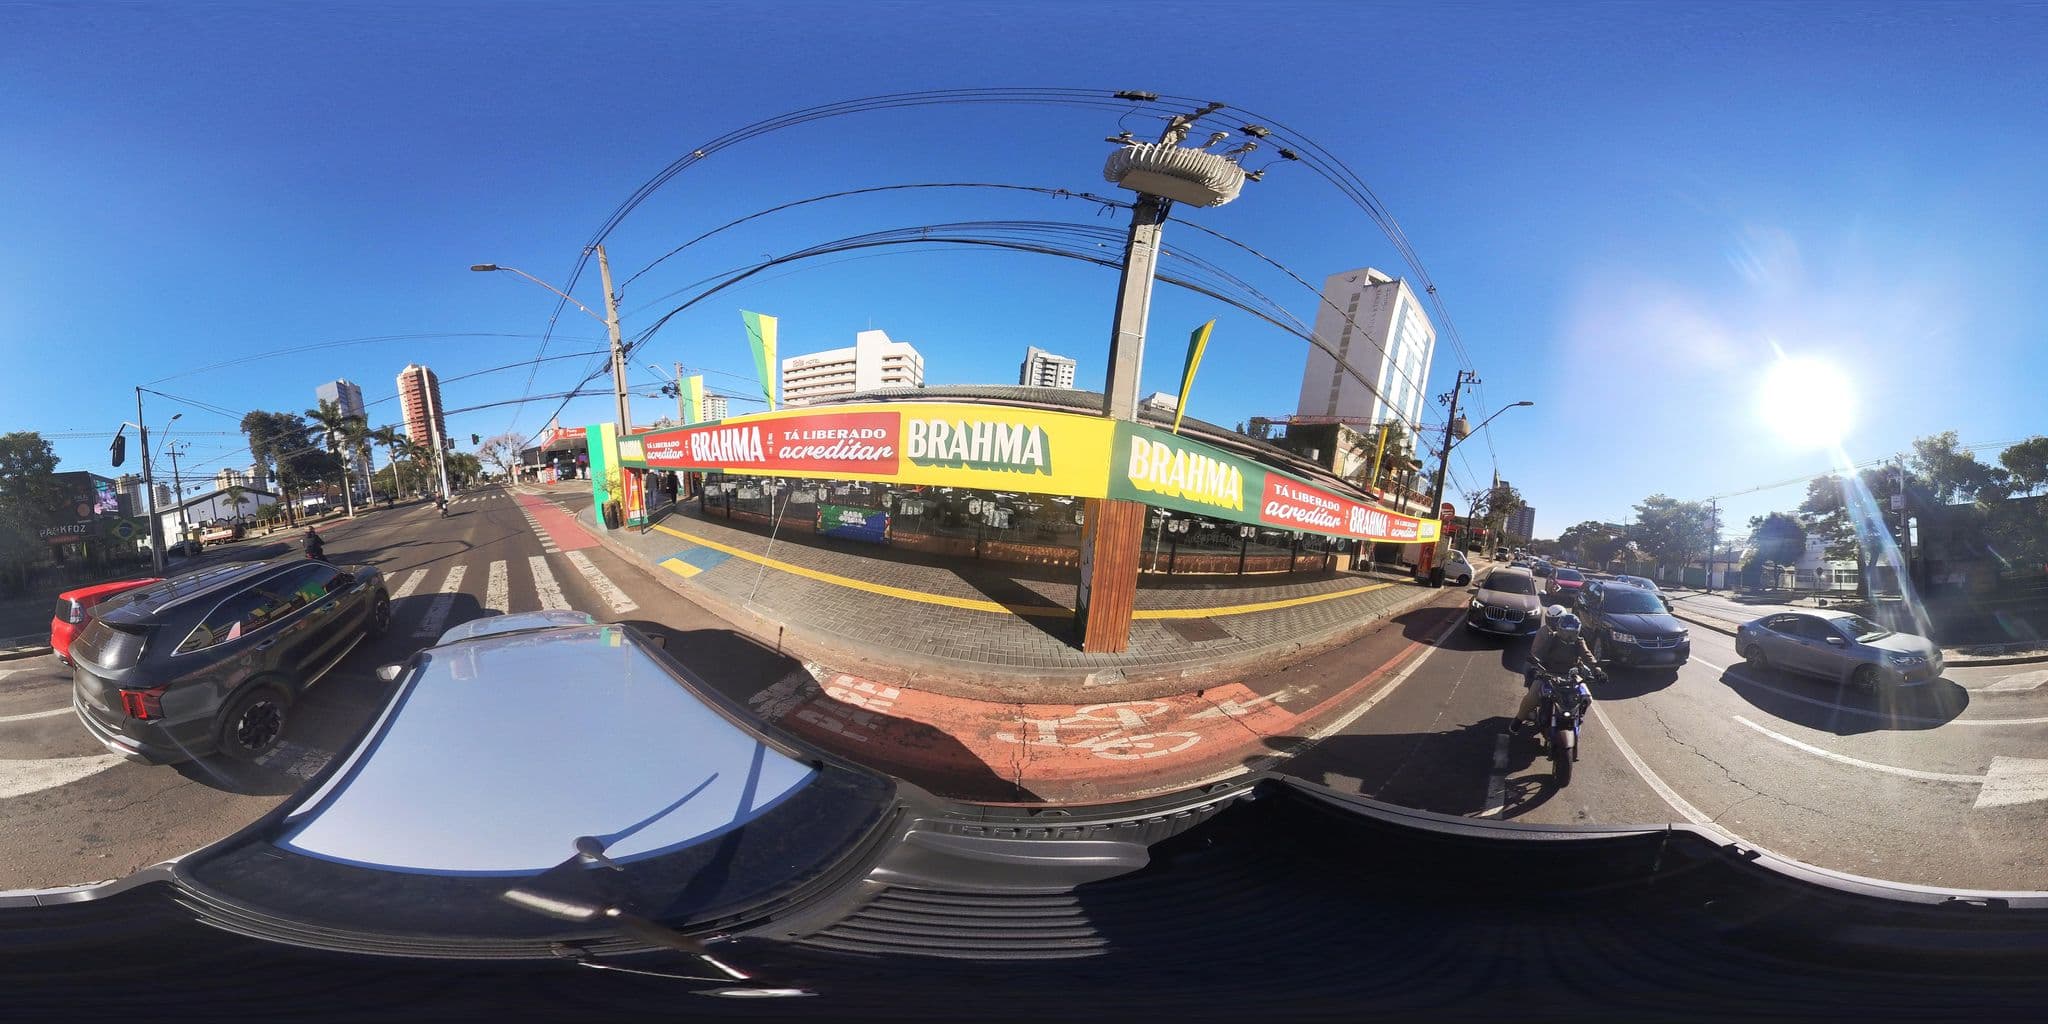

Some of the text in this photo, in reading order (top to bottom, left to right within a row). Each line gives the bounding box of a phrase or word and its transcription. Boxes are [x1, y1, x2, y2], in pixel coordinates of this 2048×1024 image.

[691, 426, 766, 462] BRAHMA
[784, 429, 886, 440] TÁ LIBERADO
[907, 418, 1044, 467] BRAHMA
[647, 448, 684, 460] acreditar
[779, 439, 894, 460] acreditar
[1128, 435, 1240, 504] BRAHMA
[1274, 484, 1340, 512] TÁ LIBERADO
[1265, 501, 1341, 528] acreditar
[1350, 506, 1388, 537] BRAHMA
